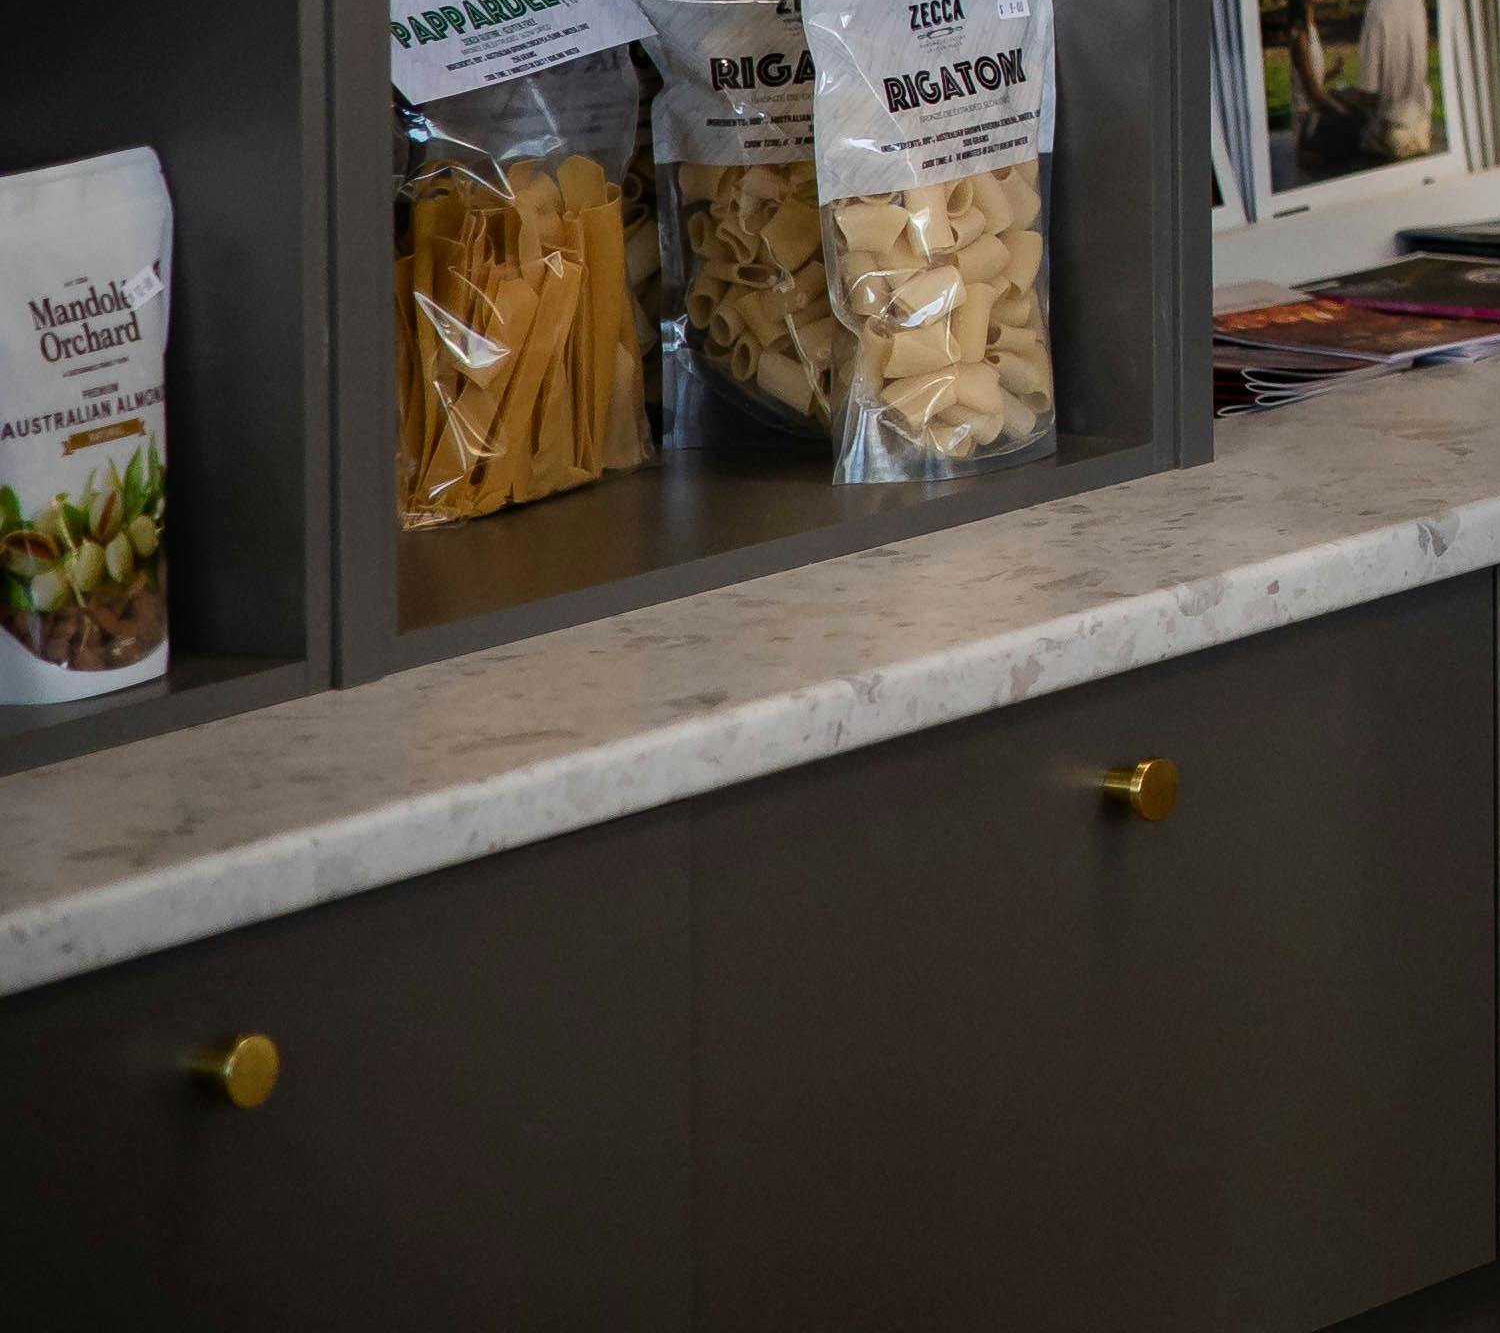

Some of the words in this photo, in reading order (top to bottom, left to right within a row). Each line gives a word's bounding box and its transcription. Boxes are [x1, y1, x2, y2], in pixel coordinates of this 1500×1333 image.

[710, 50, 816, 92] RIGA
[882, 47, 1027, 114] RIGATONI
[40, 311, 142, 363] Orchard
[1, 399, 112, 441] AUSTRALIAN
[117, 385, 165, 415] ALMON
